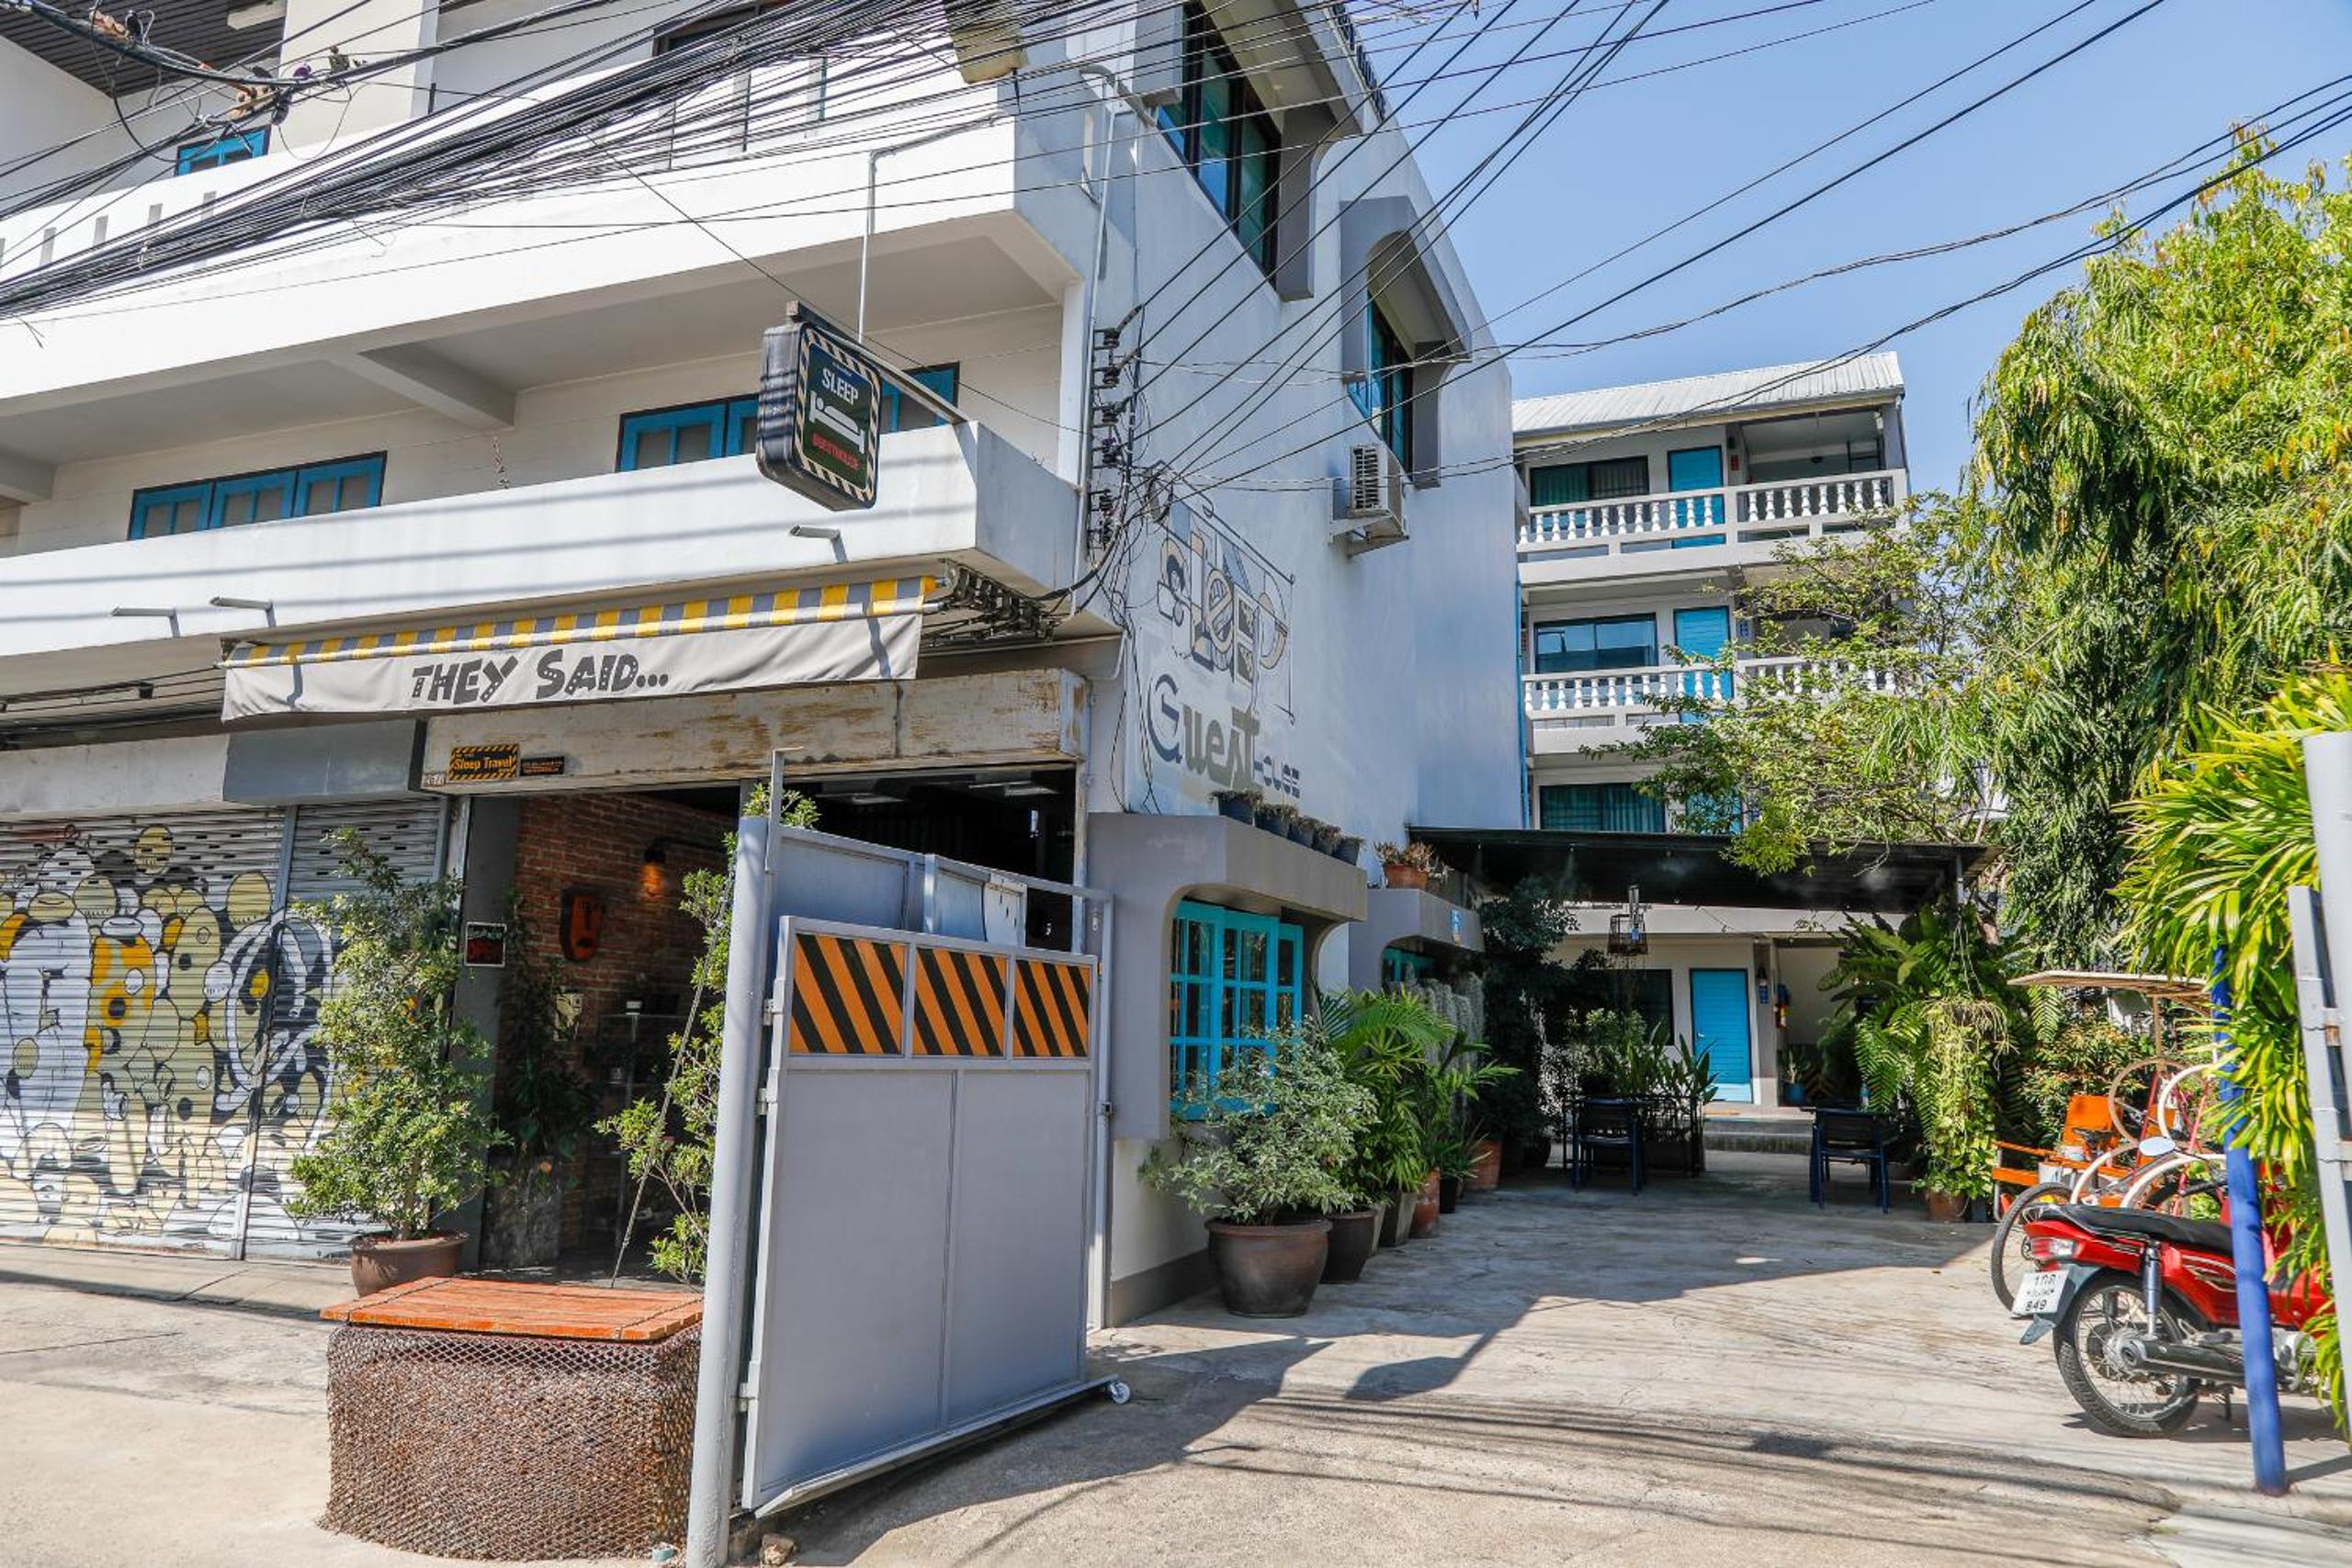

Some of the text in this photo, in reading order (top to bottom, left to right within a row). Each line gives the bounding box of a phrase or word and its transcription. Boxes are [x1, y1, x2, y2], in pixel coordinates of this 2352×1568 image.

[821, 367, 859, 406] SLEEP
[412, 655, 519, 705] THEY
[454, 758, 482, 771] Sleep
[484, 755, 513, 769] Travel
